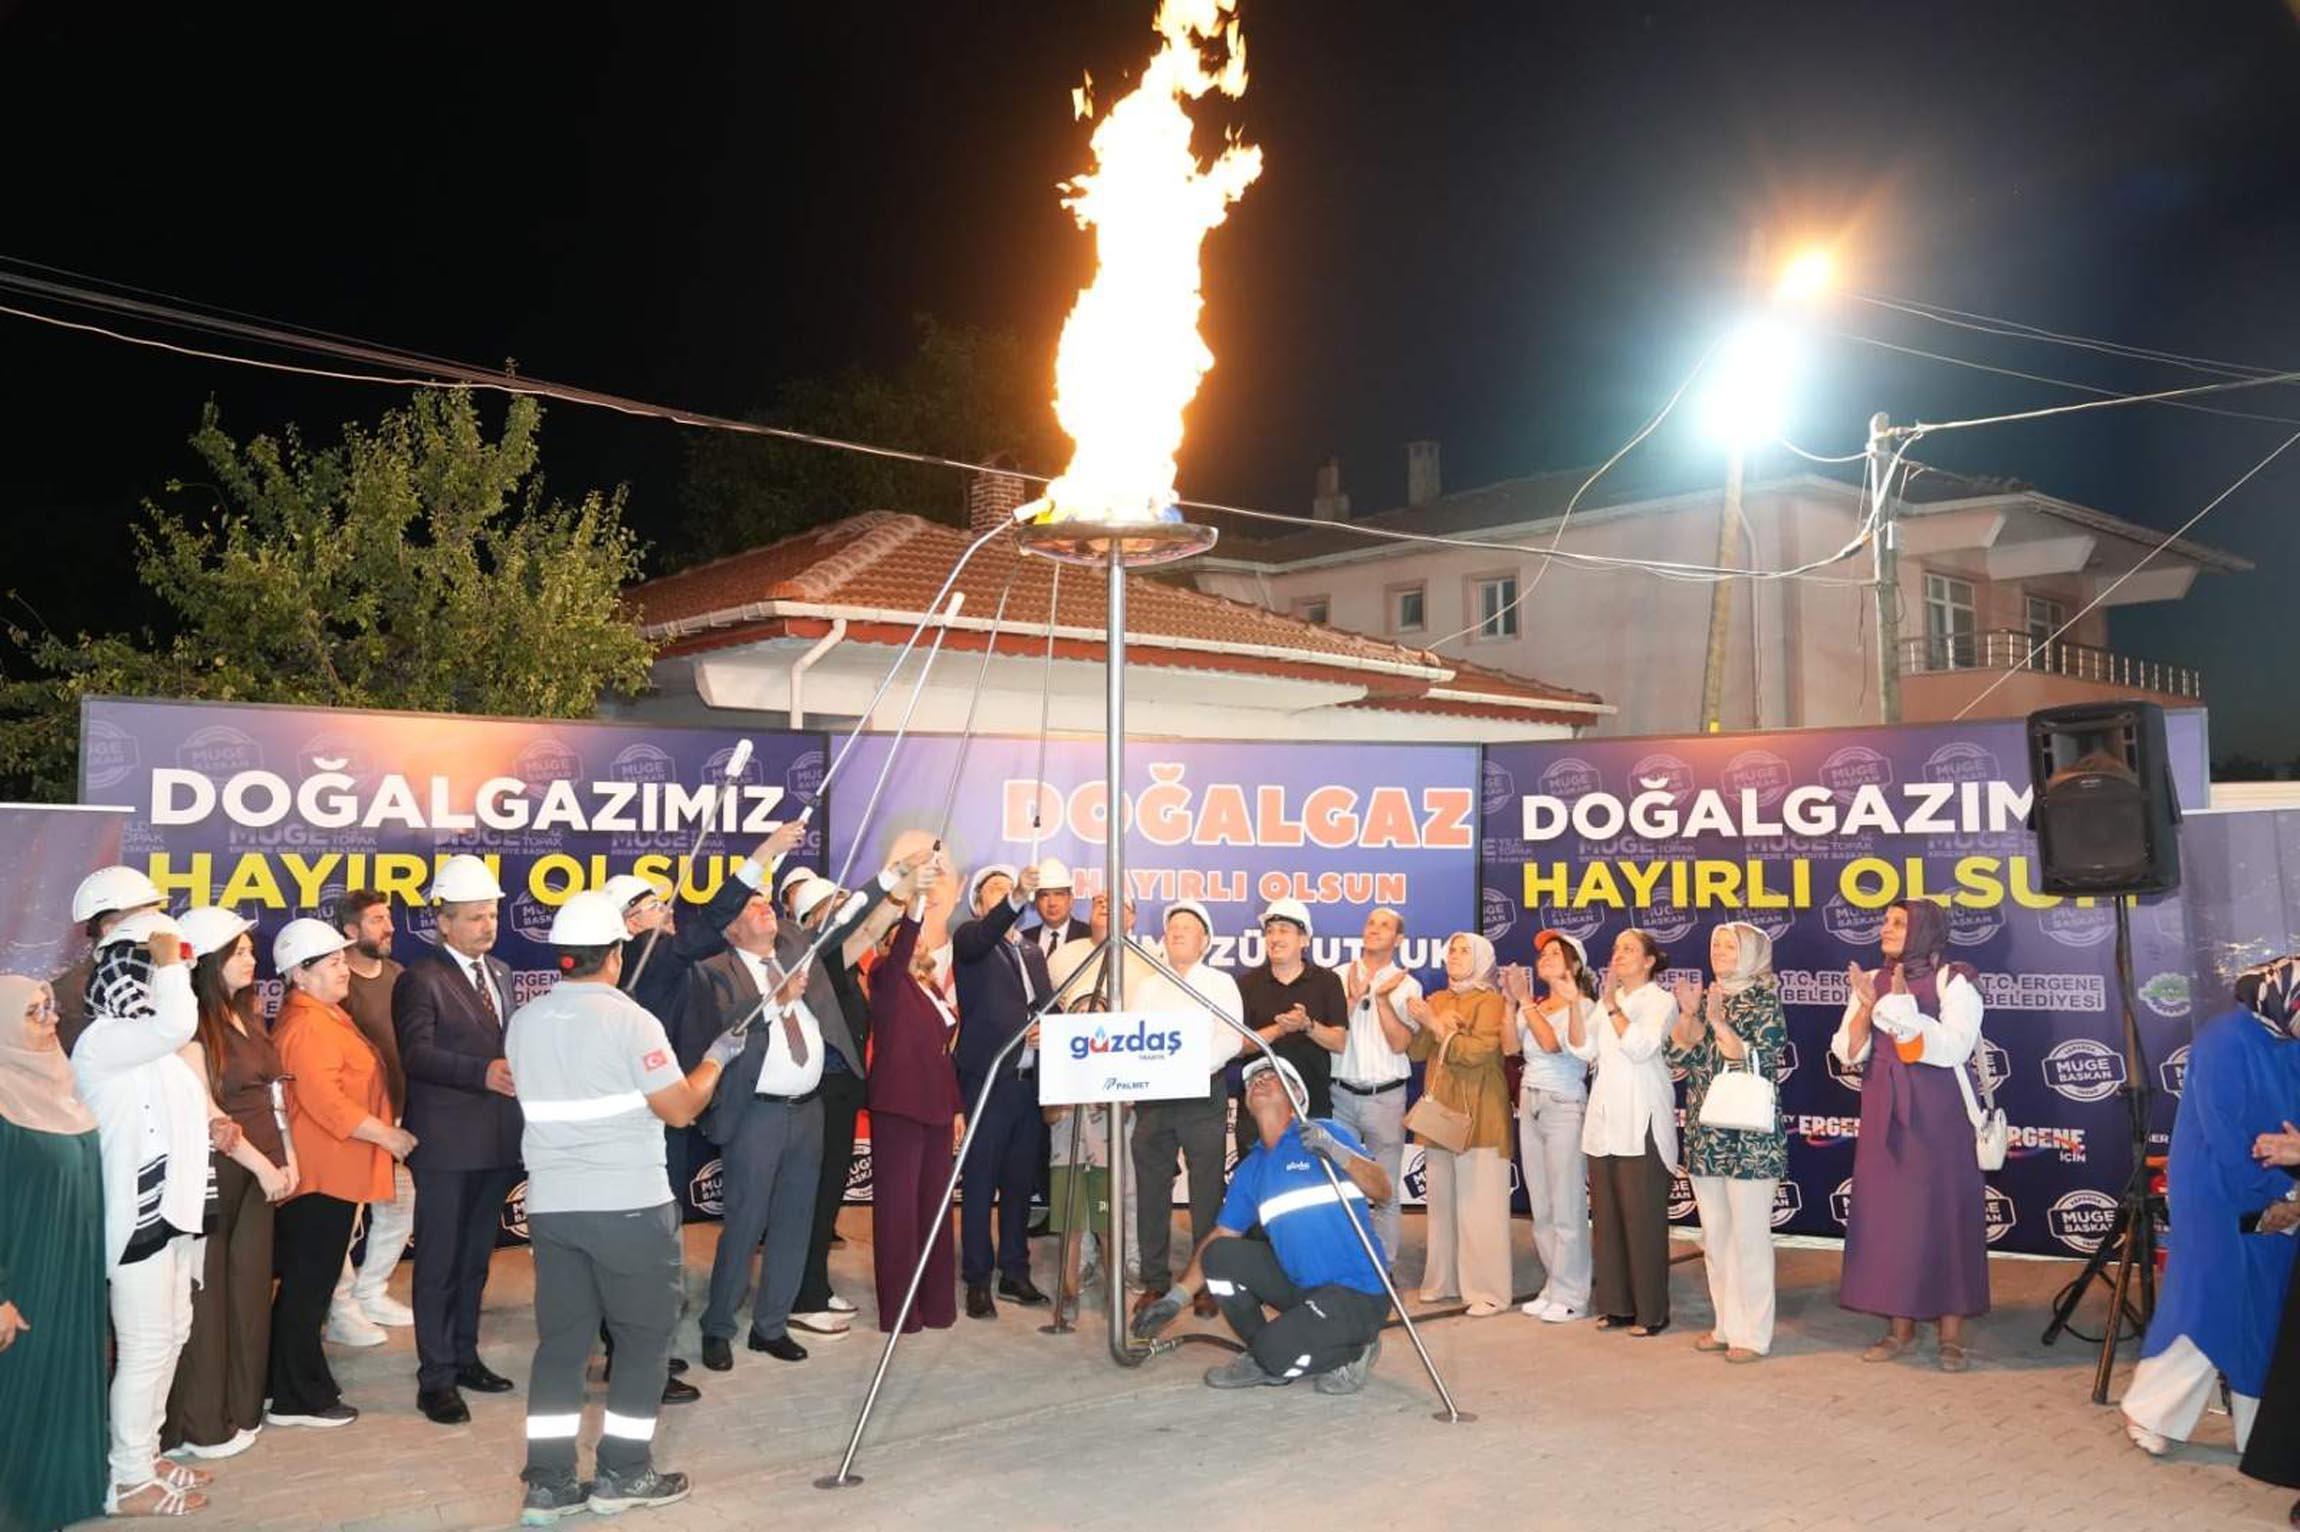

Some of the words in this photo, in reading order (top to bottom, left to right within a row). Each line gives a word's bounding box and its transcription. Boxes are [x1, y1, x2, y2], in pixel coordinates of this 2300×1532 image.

[151, 756, 784, 833] DOĞALGAZIMIZ
[1002, 763, 1472, 848] DOĞALGAZ
[1522, 776, 2034, 840] DOĞALGAZIM
[1258, 870, 1407, 904] OLSUN
[1523, 858, 1810, 909] HAYIRLI
[1839, 856, 2137, 909] OLSU
[1784, 986, 1850, 1001] BELEDİ
[1984, 990, 2103, 1009] BELEDİYESİ
[2021, 977, 2101, 992] ERGENE
[2063, 1221, 2113, 1233] BASKA
